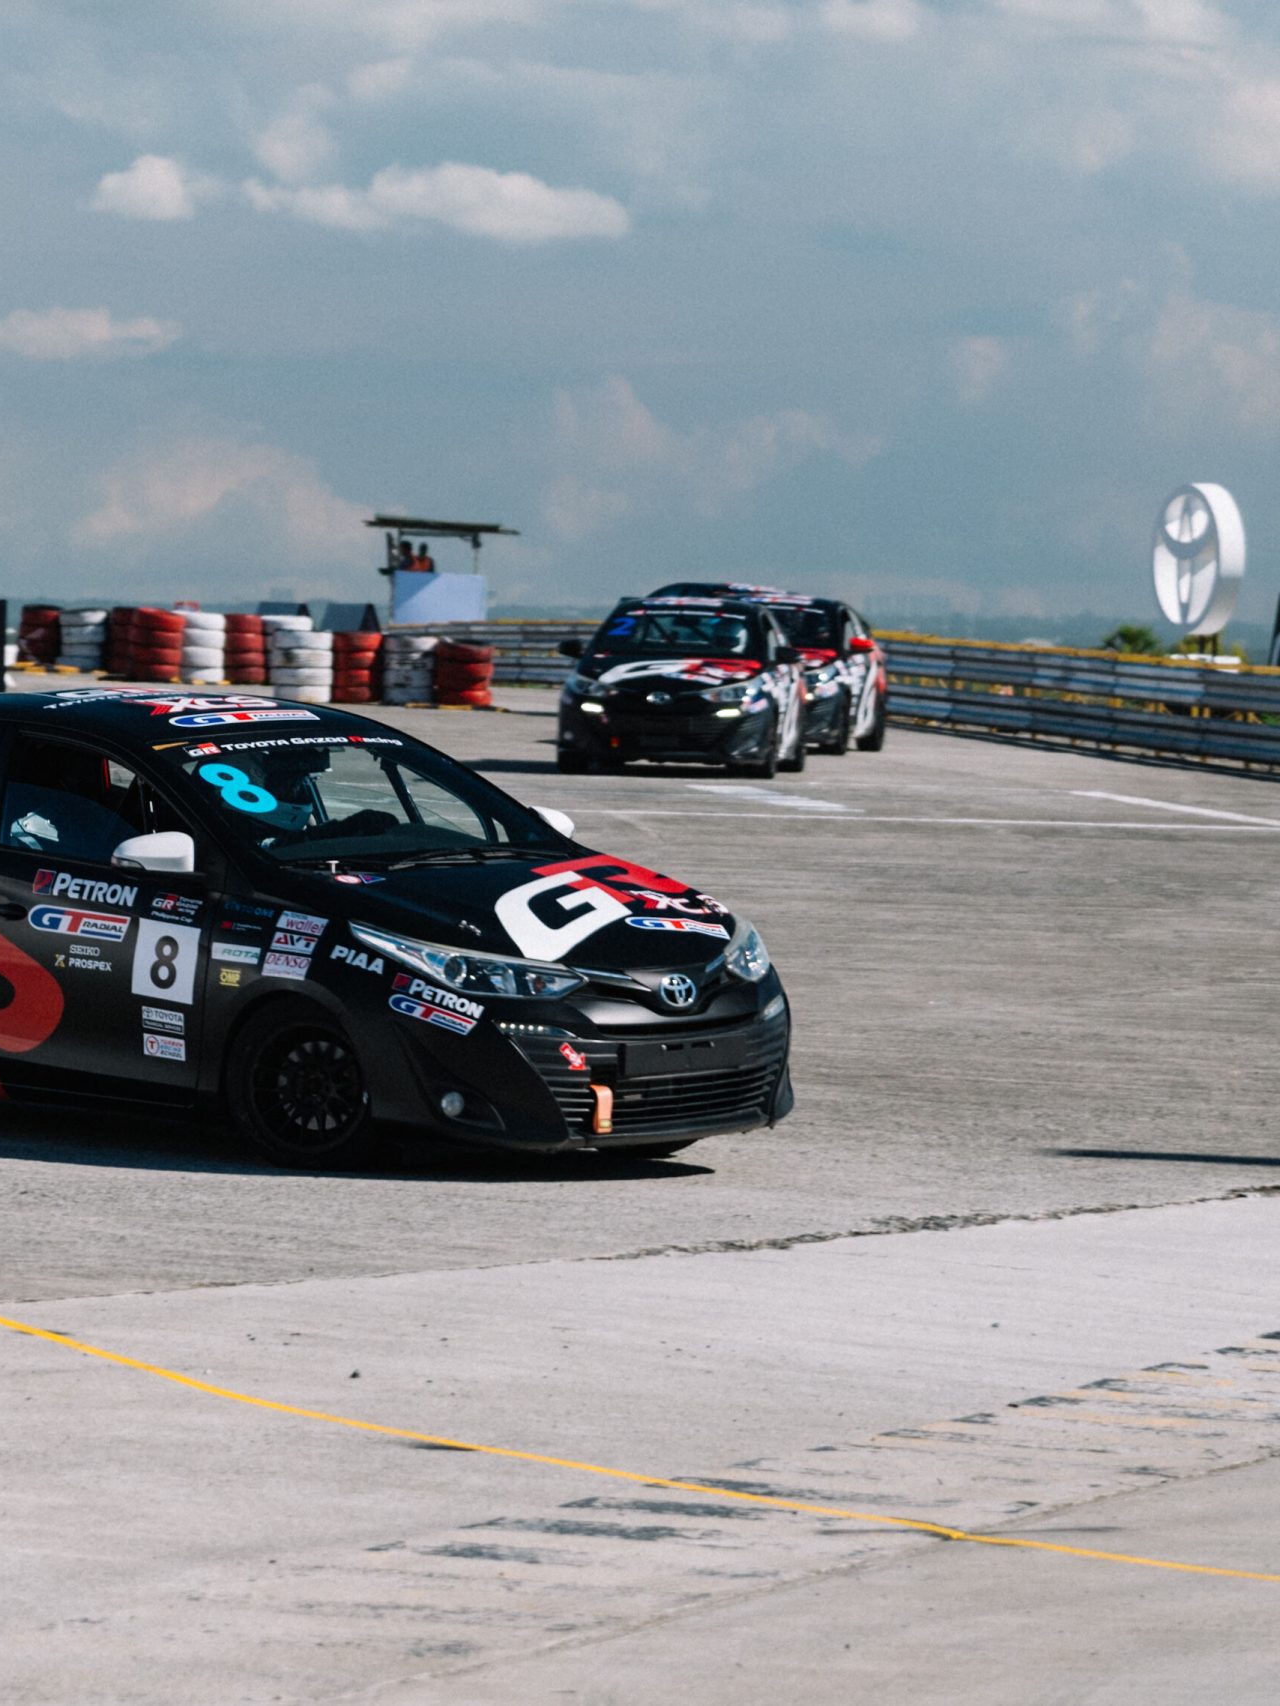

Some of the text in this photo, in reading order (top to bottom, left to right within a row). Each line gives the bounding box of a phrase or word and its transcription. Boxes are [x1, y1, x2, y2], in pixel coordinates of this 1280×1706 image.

[607, 616, 637, 637] 2
[187, 735, 404, 758] GR TOYOTA GAZOO Racing
[198, 763, 278, 814] 8
[52, 872, 139, 907] PETRON
[151, 897, 176, 910] GR
[493, 853, 691, 962] GR
[39, 909, 124, 934] GT RADIAL
[69, 943, 101, 957] SEIKO
[274, 933, 317, 949] AVT
[68, 956, 113, 972] PROSPEX
[150, 935, 179, 989] 8
[222, 948, 259, 961] ROTA
[266, 953, 311, 969] DENSO
[329, 944, 385, 976] PIAA
[407, 978, 485, 1019] PETRON
[154, 1010, 183, 1022] TOYOTA
